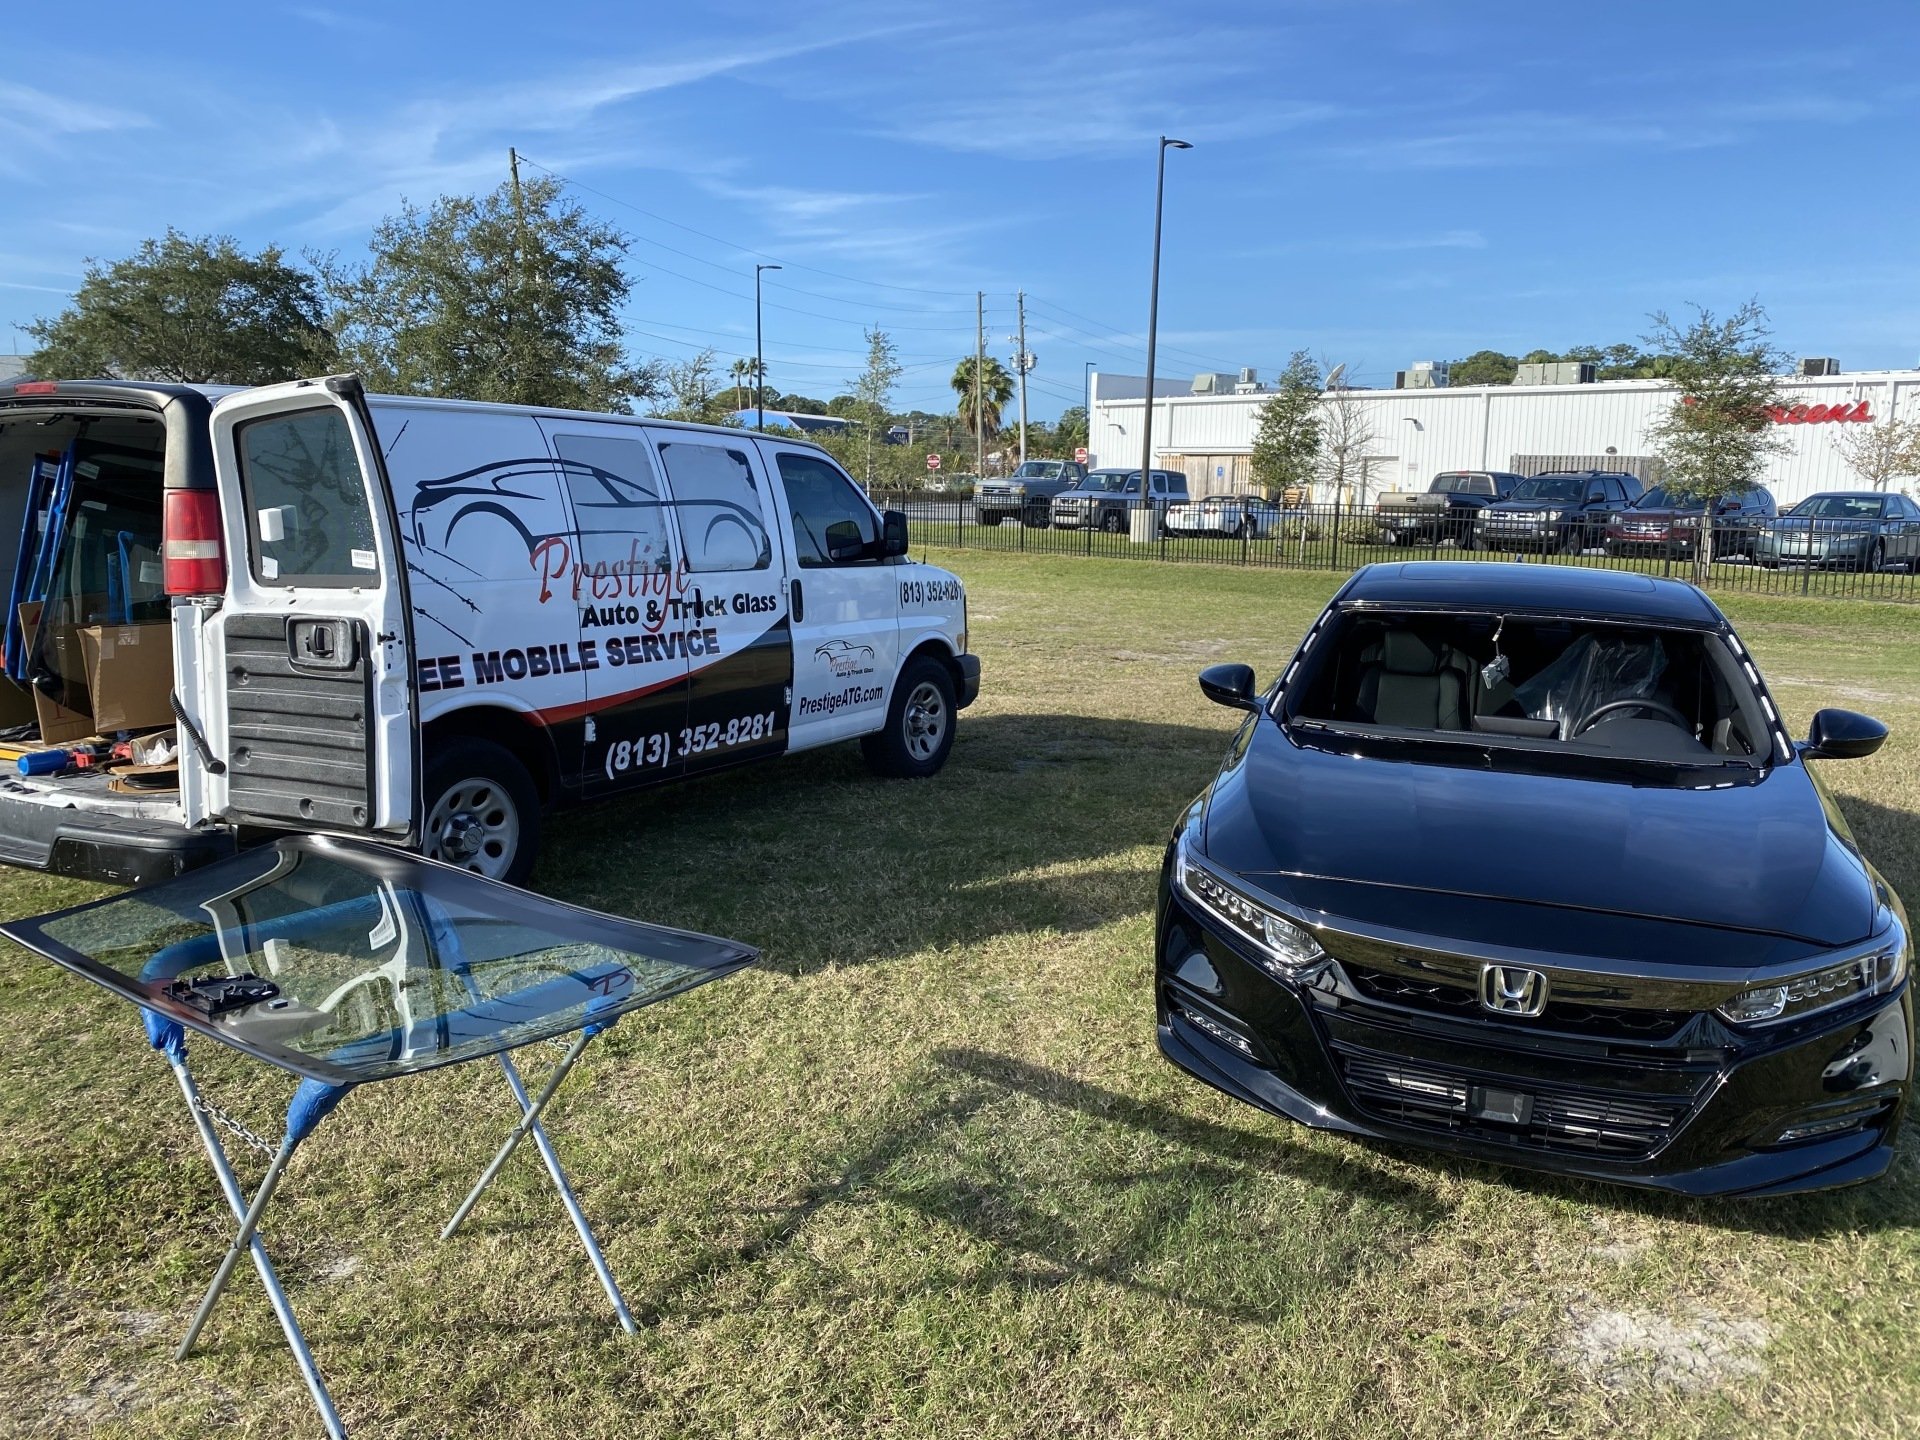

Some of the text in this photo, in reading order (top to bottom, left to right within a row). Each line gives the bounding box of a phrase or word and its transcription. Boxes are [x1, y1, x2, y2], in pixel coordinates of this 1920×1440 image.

[529, 537, 691, 632] Prestige
[900, 580, 962, 609] (813) 352-8281
[581, 593, 777, 628] Auto & Truck Glass
[418, 628, 721, 692] EE MOBILE SERVICE
[799, 686, 883, 716] PrestigeATG.com
[605, 711, 775, 780] (813) 352-8281
